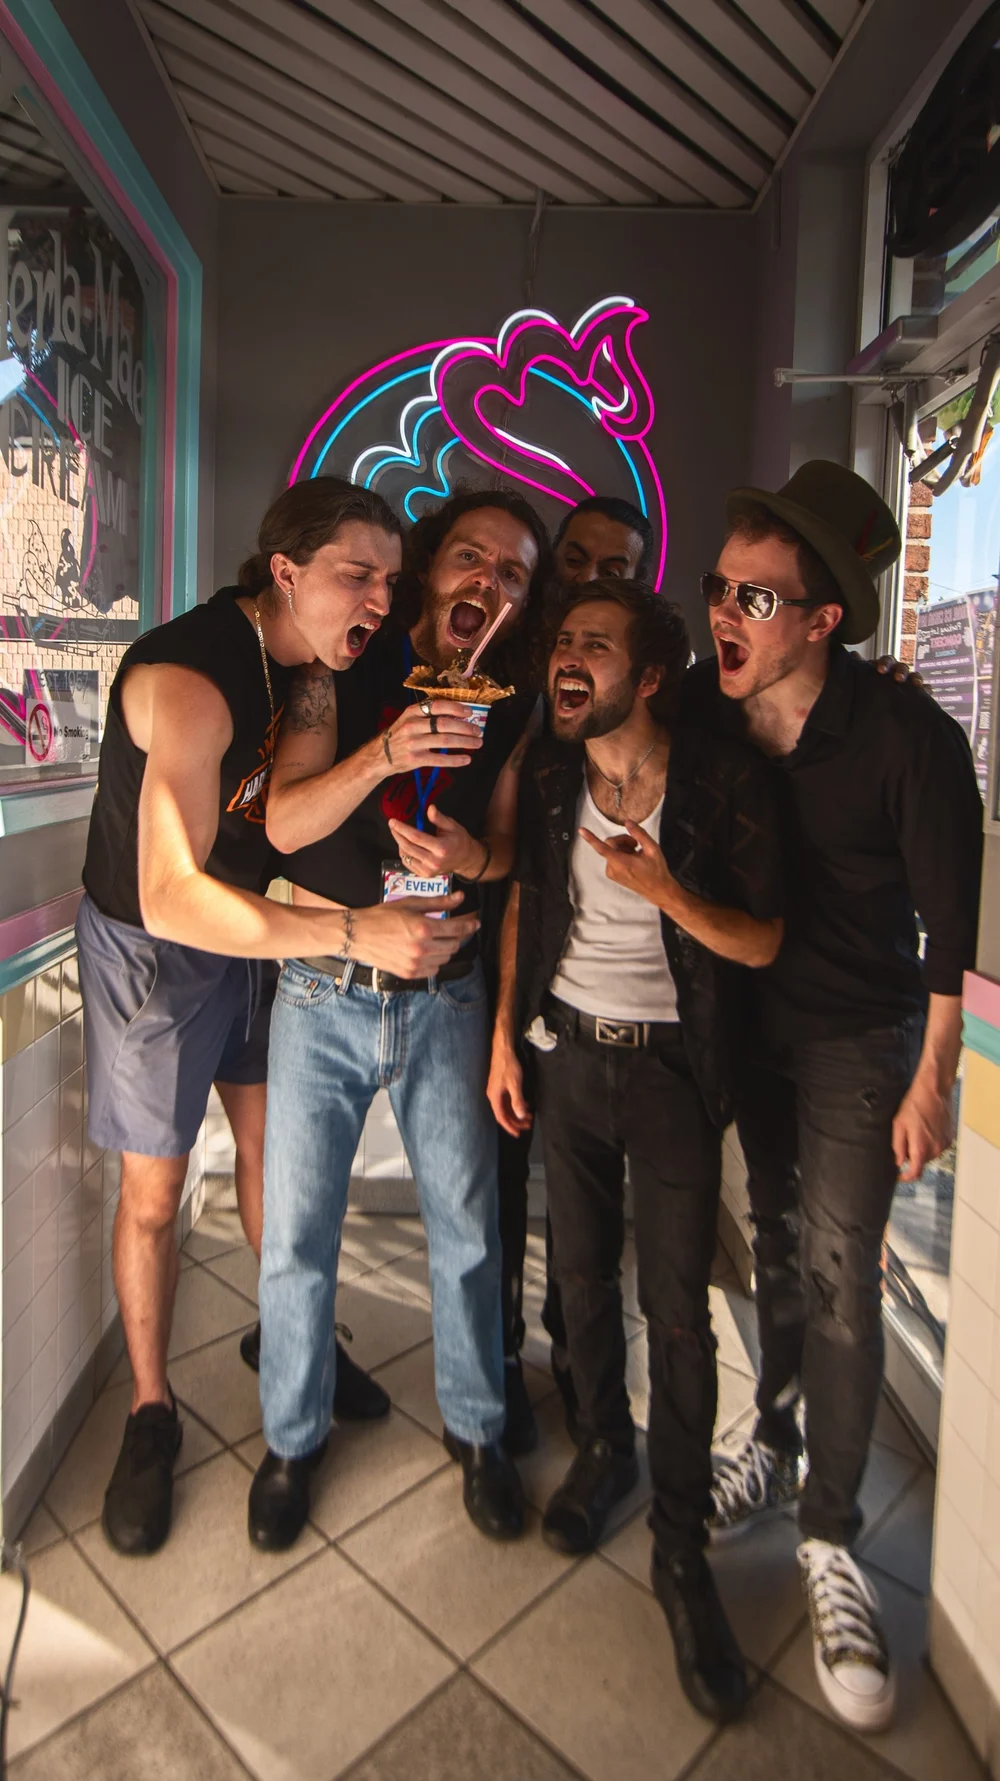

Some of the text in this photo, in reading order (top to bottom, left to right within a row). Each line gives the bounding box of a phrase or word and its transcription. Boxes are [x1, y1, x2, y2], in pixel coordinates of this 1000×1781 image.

[57, 356, 114, 458] ICE
[0, 399, 128, 537] CREAM
[63, 671, 89, 691] 1957
[53, 725, 89, 740] No Smoking
[406, 880, 442, 893] EVENT
